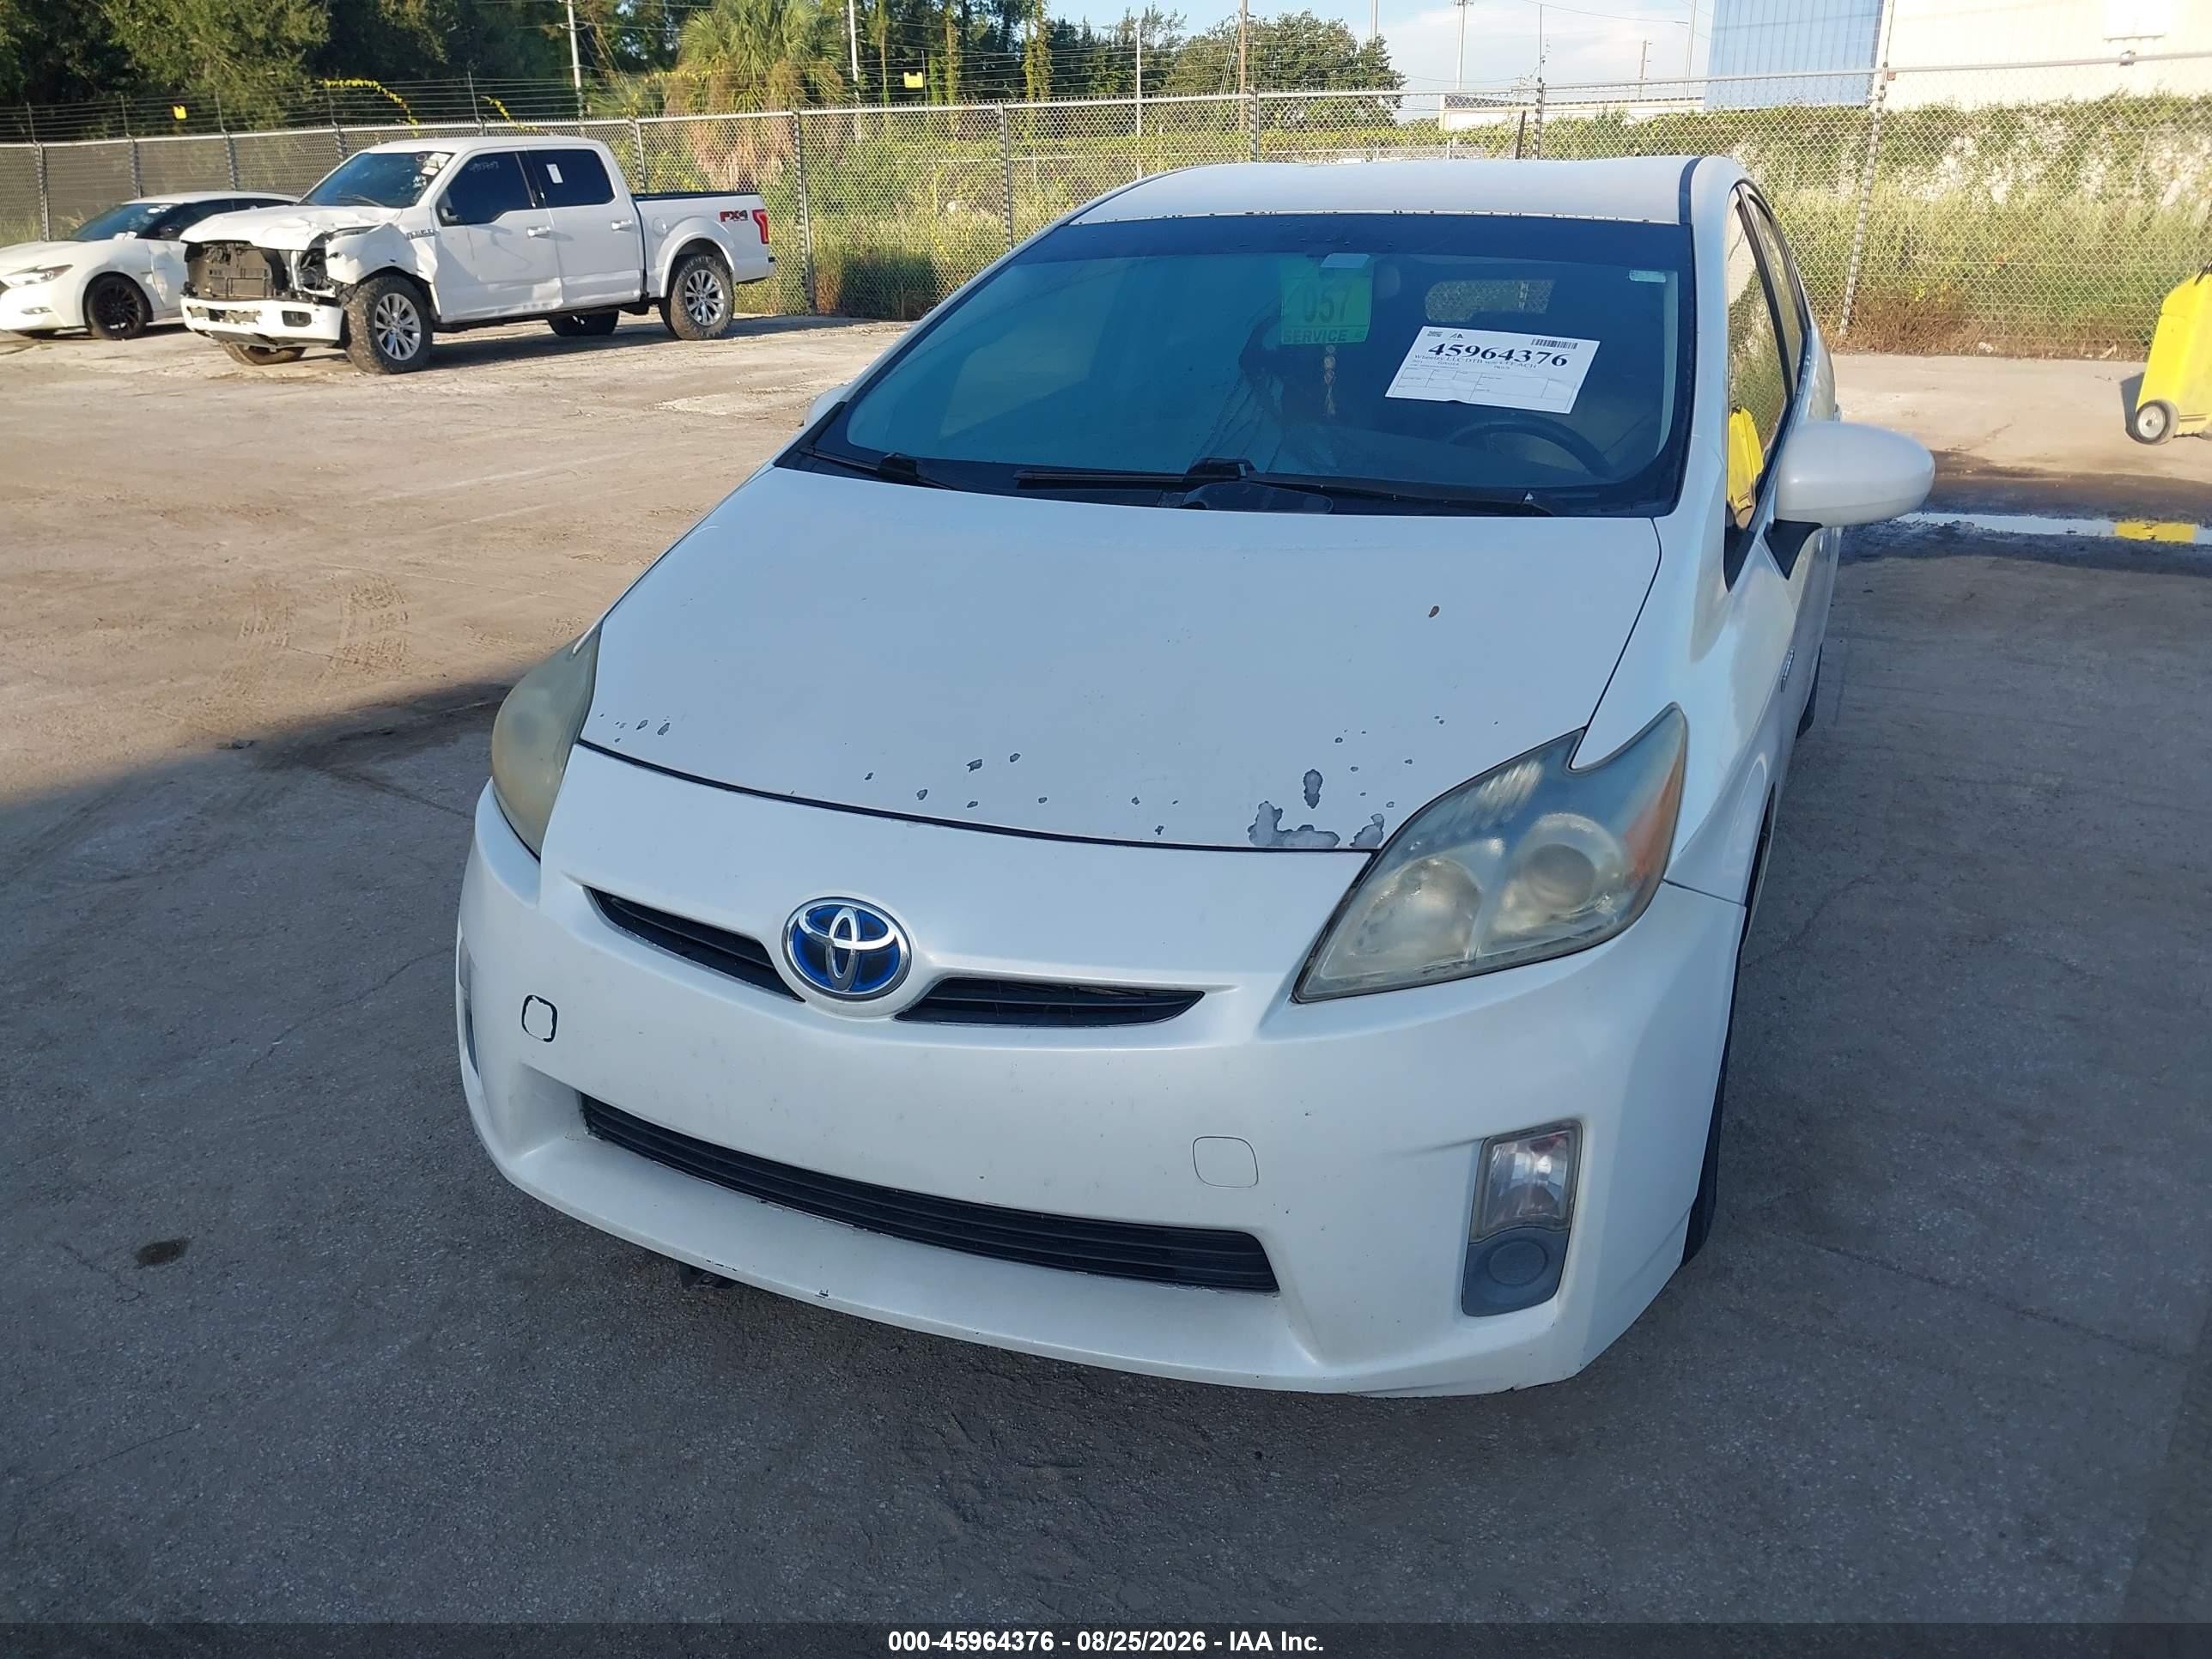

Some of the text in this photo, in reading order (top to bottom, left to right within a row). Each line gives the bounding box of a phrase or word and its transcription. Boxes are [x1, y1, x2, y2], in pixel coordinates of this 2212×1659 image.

[720, 210, 749, 222] FX4
[1302, 284, 1352, 324] 057
[1283, 329, 1347, 343] SERVICE
[1428, 343, 1571, 367] 45964376
